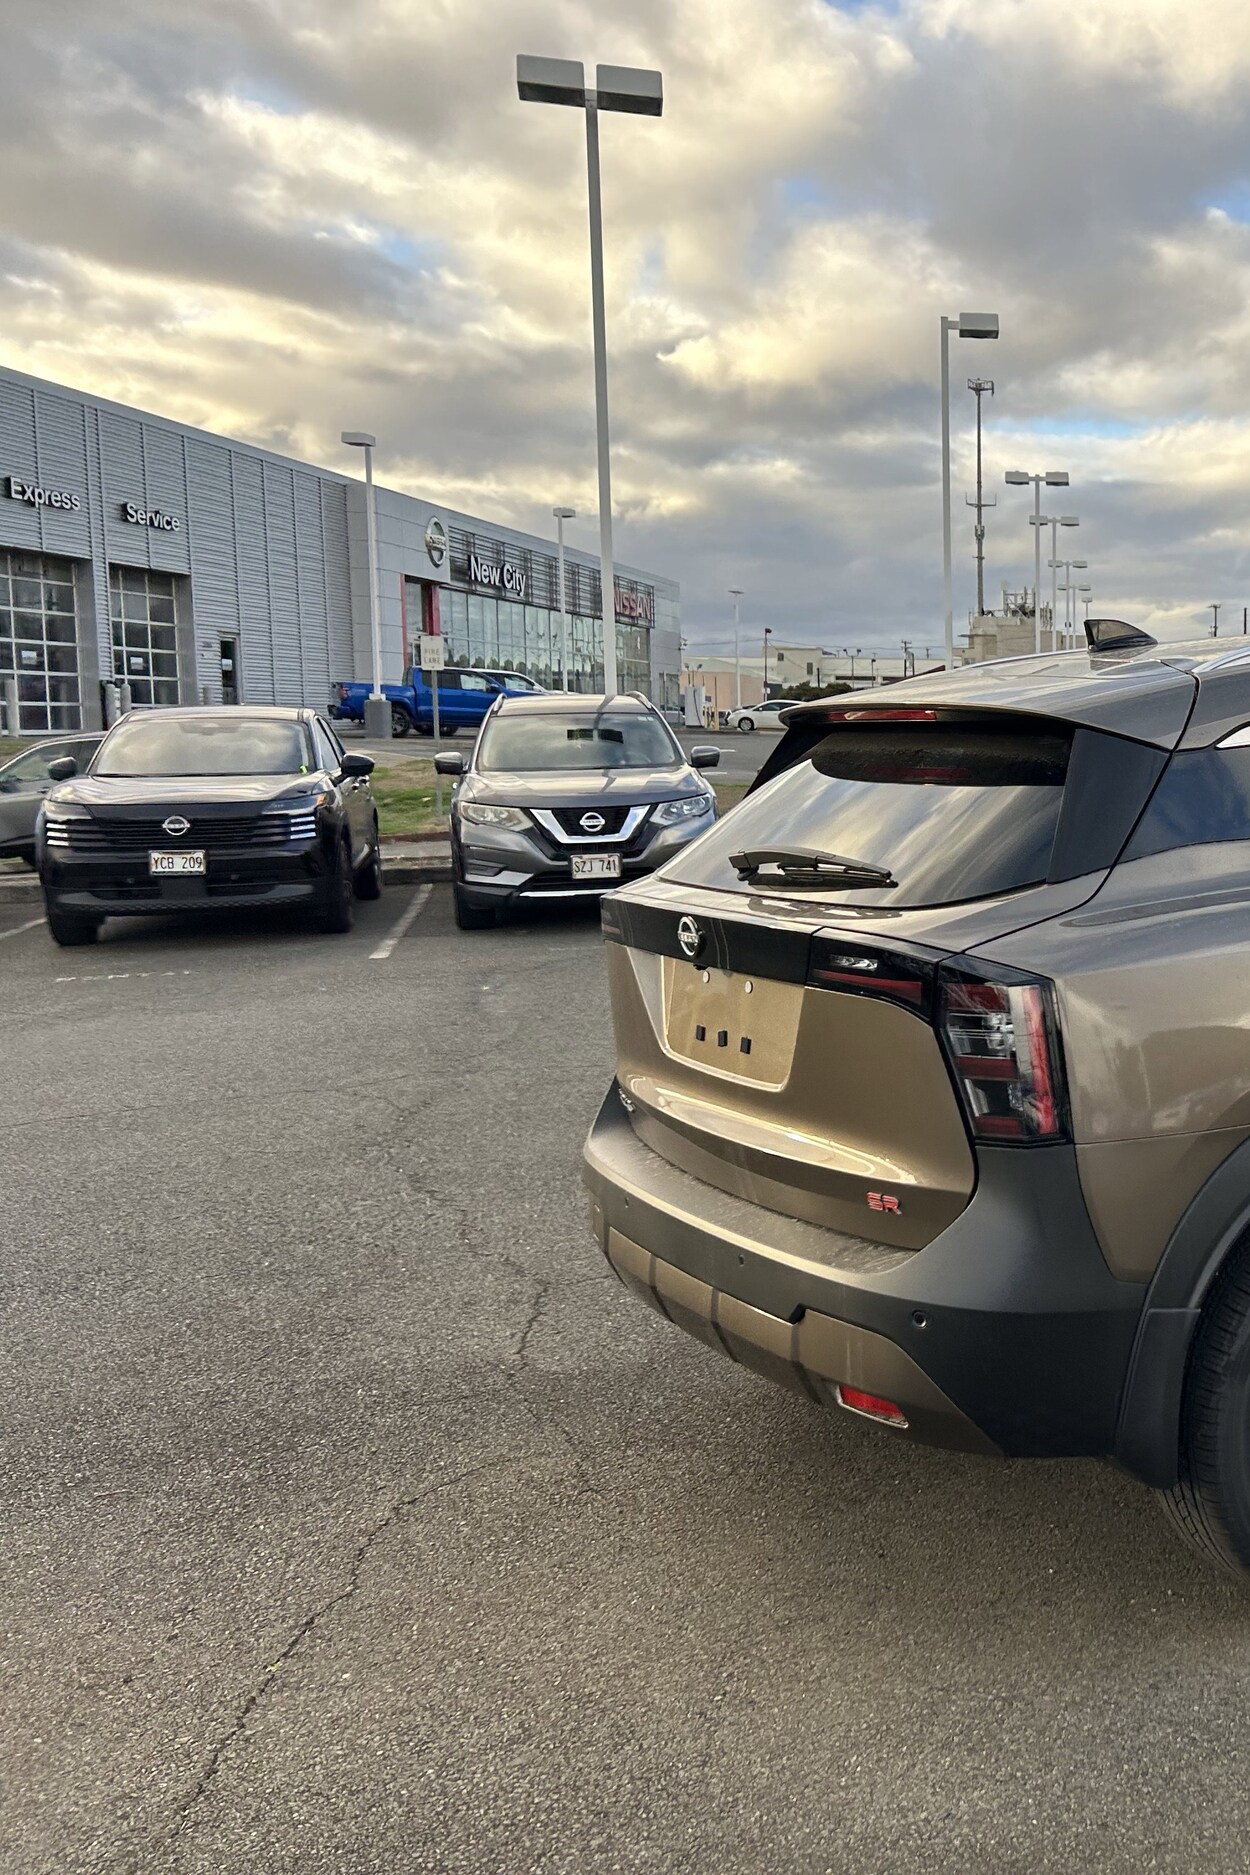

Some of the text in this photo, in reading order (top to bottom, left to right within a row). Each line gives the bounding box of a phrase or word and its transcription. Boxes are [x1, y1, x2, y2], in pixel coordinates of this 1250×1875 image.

[10, 476, 81, 511] Express
[126, 502, 181, 531] Service
[470, 555, 526, 597] New City
[613, 588, 651, 620] NISSAN
[153, 856, 203, 870] YCB 209
[574, 859, 617, 873] SZJ 741
[866, 1191, 902, 1215] SR
